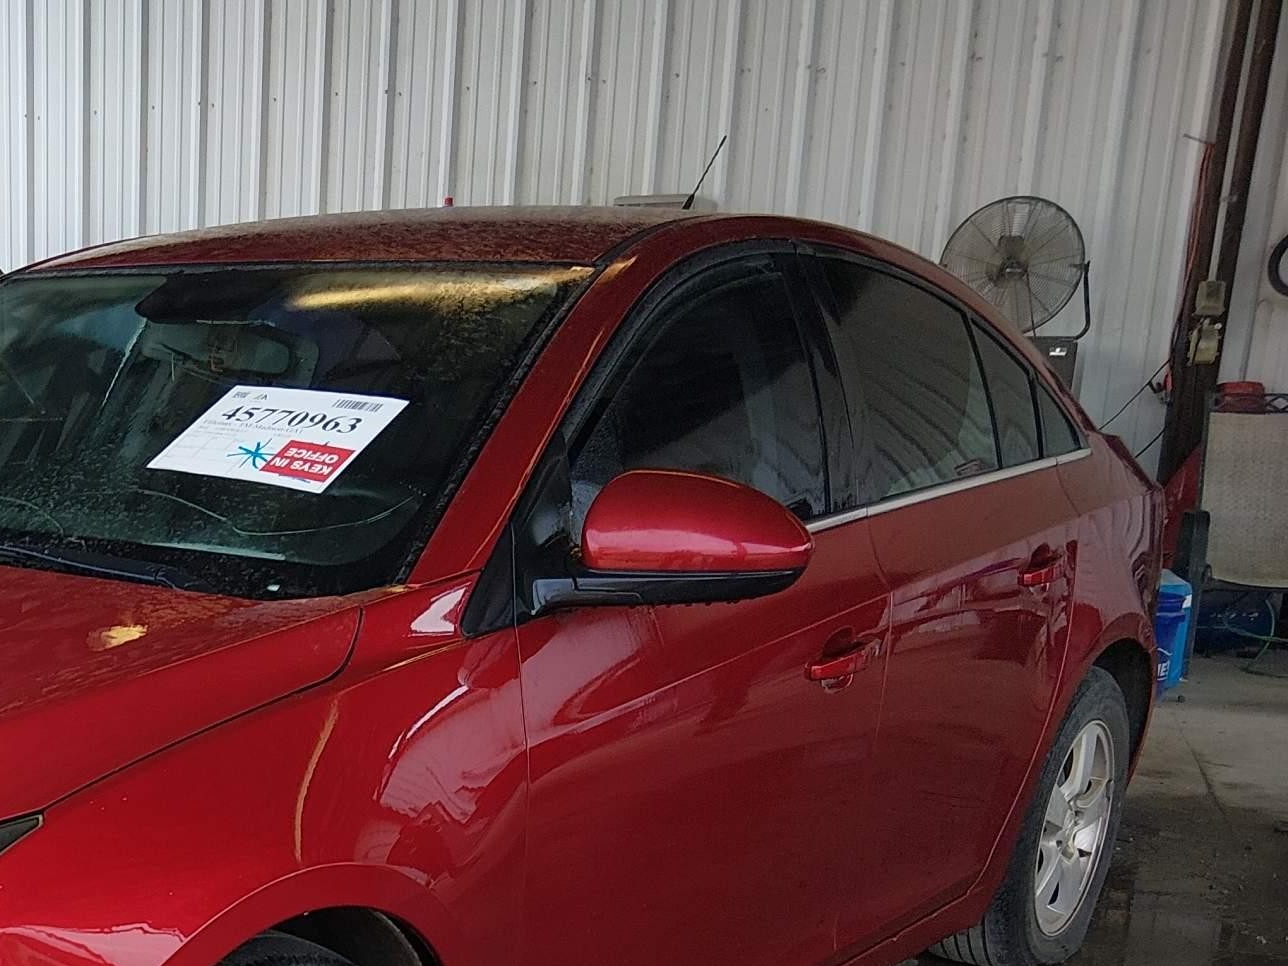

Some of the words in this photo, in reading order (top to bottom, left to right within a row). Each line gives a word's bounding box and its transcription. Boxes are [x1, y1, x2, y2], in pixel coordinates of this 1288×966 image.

[222, 405, 363, 433] 45770963
[270, 456, 290, 468] IN
[284, 447, 340, 464] OFFICE
[290, 460, 333, 475] KEYS
